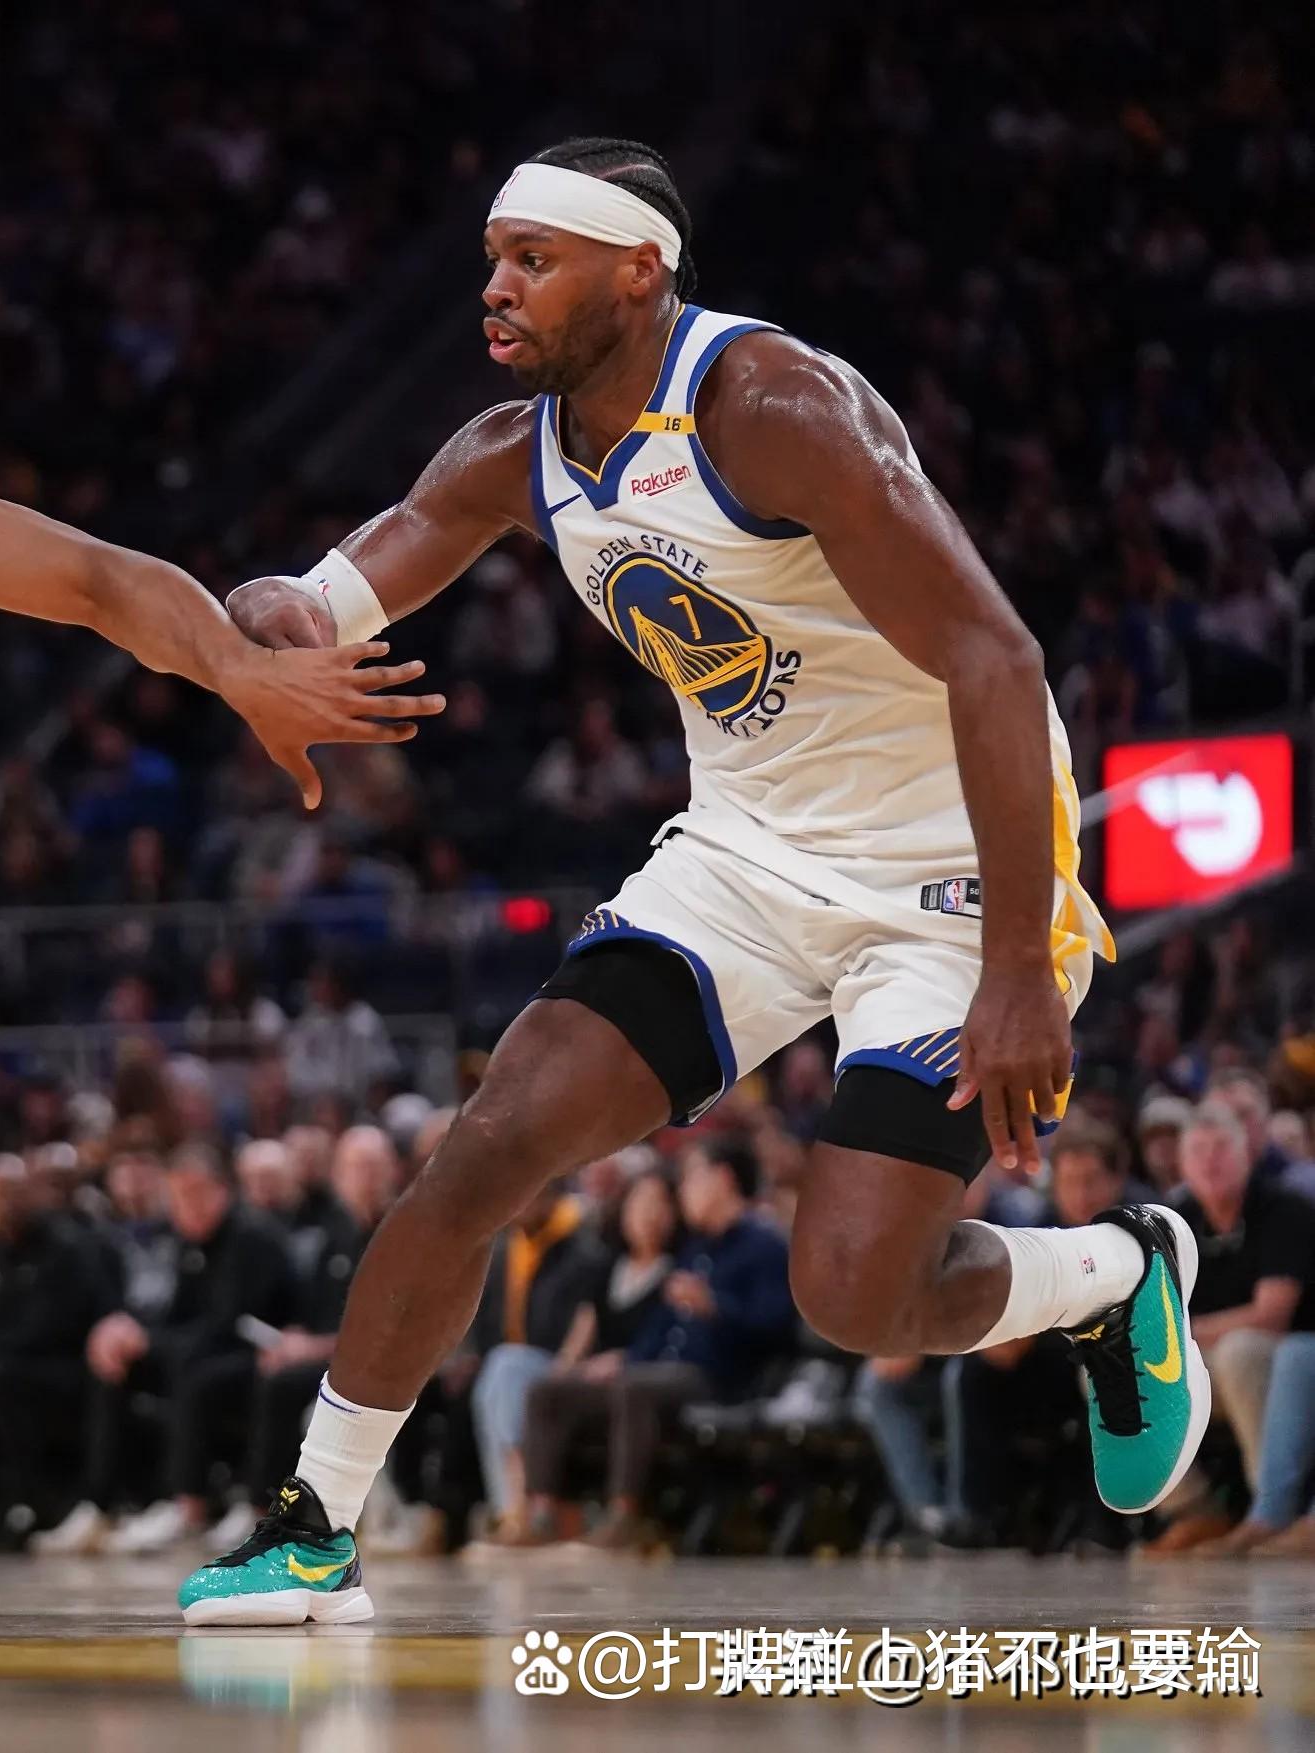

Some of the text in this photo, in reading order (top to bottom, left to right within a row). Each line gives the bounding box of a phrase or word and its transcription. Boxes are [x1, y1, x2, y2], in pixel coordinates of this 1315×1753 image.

[664, 416, 682, 432] 16
[631, 464, 692, 497] Rakuten
[586, 534, 710, 606] GOLDEN STATE
[669, 593, 703, 640] 7
